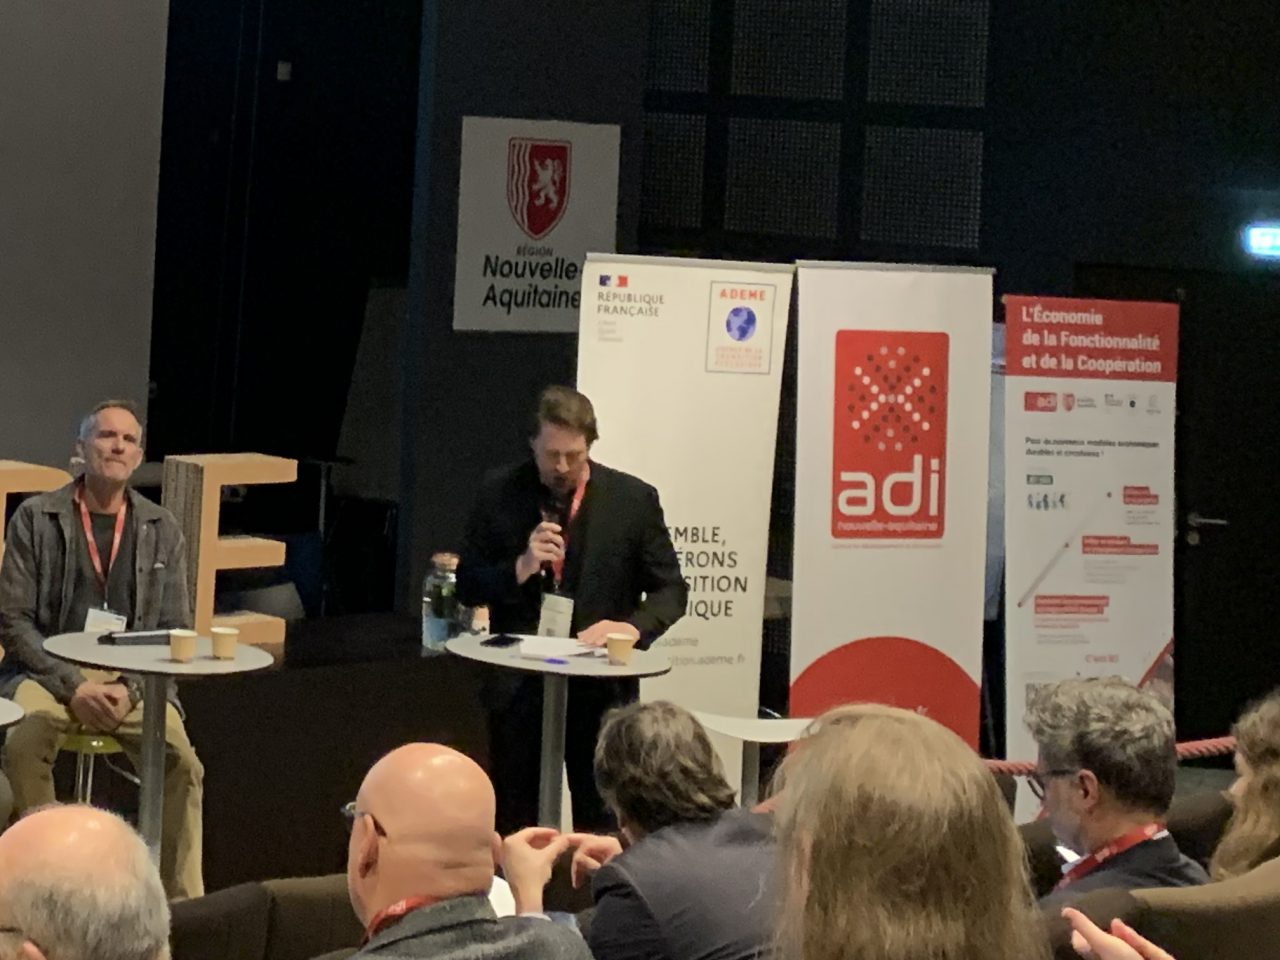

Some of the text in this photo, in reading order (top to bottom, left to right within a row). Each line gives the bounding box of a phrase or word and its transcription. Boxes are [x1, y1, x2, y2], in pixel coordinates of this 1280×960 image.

[597, 290, 665, 305] RÉPUBLIQUE
[719, 288, 766, 301] ADEME
[597, 305, 660, 318] FRANÇAISE
[1022, 303, 1104, 325] L'Économie
[1022, 328, 1161, 351] de la Fonctionnalité
[1022, 354, 1037, 369] et
[1039, 353, 1058, 370] de
[1061, 354, 1074, 371] la
[837, 453, 940, 517] adi
